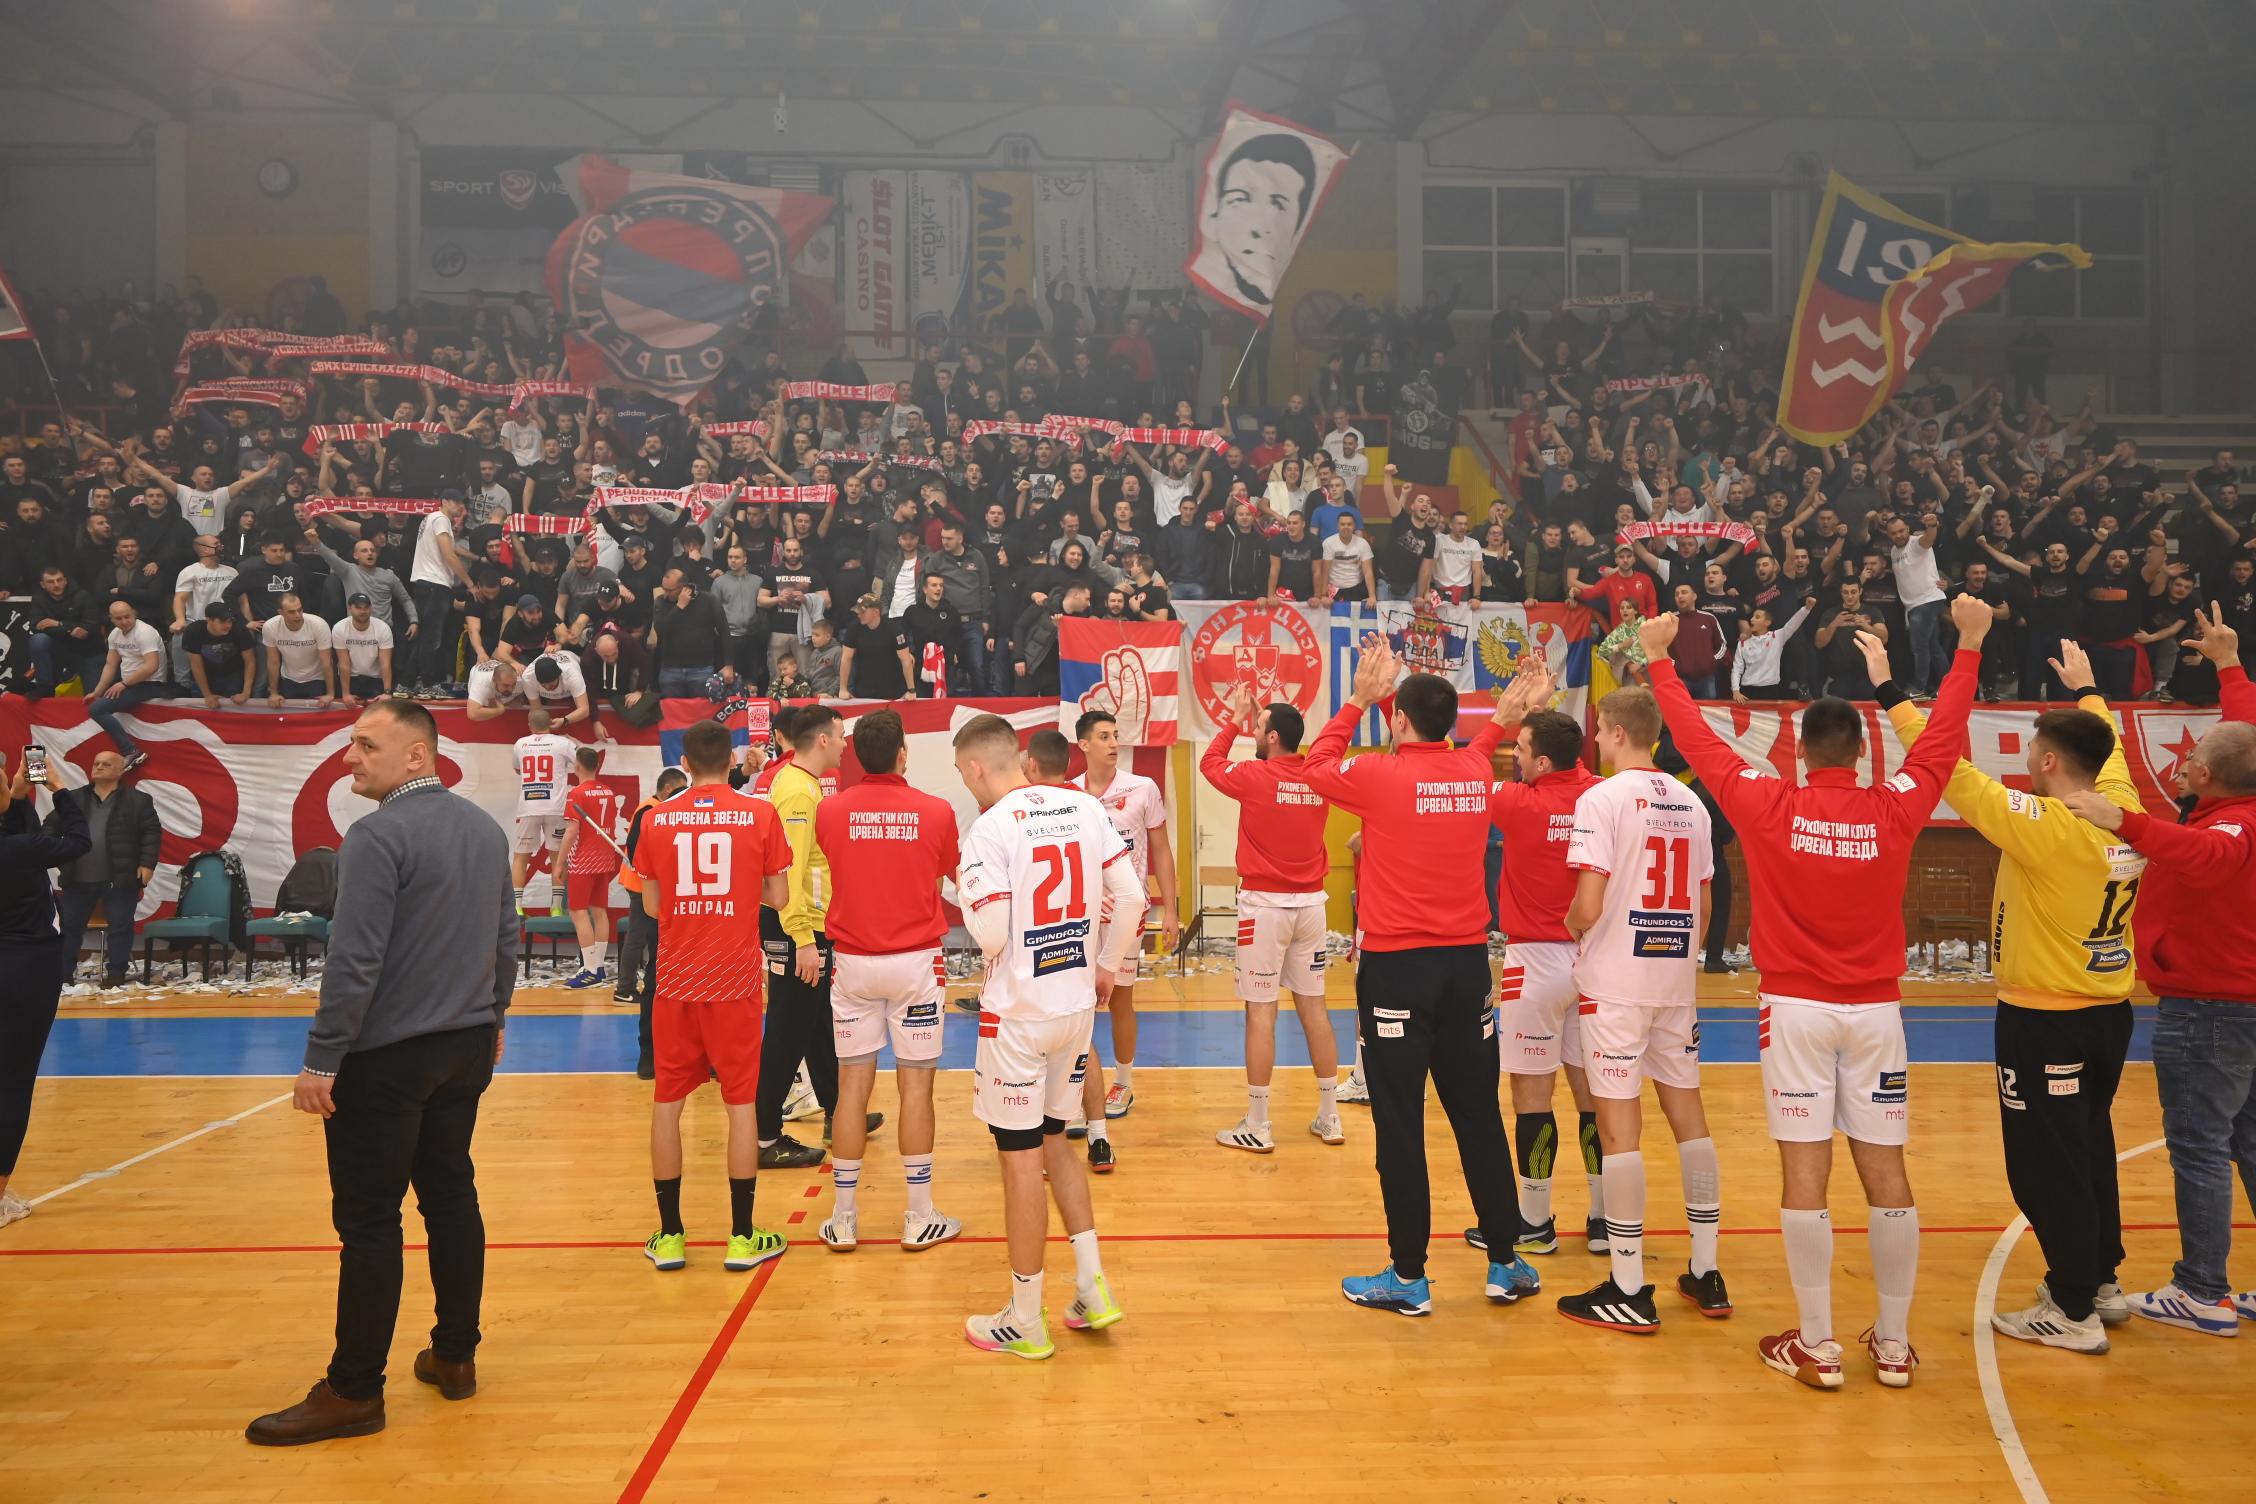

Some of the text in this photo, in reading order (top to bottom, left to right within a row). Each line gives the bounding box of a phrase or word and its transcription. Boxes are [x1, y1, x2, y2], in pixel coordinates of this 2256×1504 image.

[430, 180, 495, 195] SPORT
[856, 217, 870, 311] CASINO
[872, 259, 893, 350] GAME
[618, 410, 647, 418] adidas
[775, 575, 812, 584] WELCOME
[522, 755, 554, 782] 99
[1416, 780, 1486, 796] РУКОМЕТНИ КЛУБ
[1276, 791, 1302, 805] ЦРВЕНА
[599, 798, 608, 827] 7
[1029, 805, 1078, 819] PRIMOBET
[1416, 796, 1487, 816] ЦРВЕНА ЗВЕЗДА
[1651, 801, 1694, 813] PRIMOBET
[654, 810, 755, 827] РК ЦРВЕНА ЗВЕЗДА
[850, 811, 920, 825] РУКОМЕТНИ КЛУБ
[849, 825, 919, 842] ЦРВЕНА ЗВЕЗДА
[1792, 815, 1877, 840] РУКОМЕТНИ КЛУБ
[1790, 832, 1879, 862] ЦРВЕНА ЗВЕЗДА
[672, 831, 733, 897] 19
[1641, 835, 1691, 911] 31
[1032, 840, 1087, 927] 21
[2088, 877, 2139, 940] 12
[1630, 917, 1686, 928] GRUNDFOS
[1025, 927, 1084, 946] GRUNDFOS
[1645, 935, 1685, 946] ADMIRAL
[1040, 945, 1083, 962] ADMIRAL
[2099, 952, 2128, 962] ADMIRAL
[1254, 980, 1272, 989] mts
[912, 1030, 933, 1041] mts
[1379, 1025, 1401, 1036] mts
[1523, 1046, 1547, 1057] mts
[1602, 1066, 1629, 1079] mts
[1002, 1080, 1038, 1089] PRIMOBET
[1997, 1065, 2018, 1097] 12
[2051, 1083, 2077, 1093] mts
[1003, 1095, 1029, 1106] mts
[1781, 1106, 1810, 1118] mts
